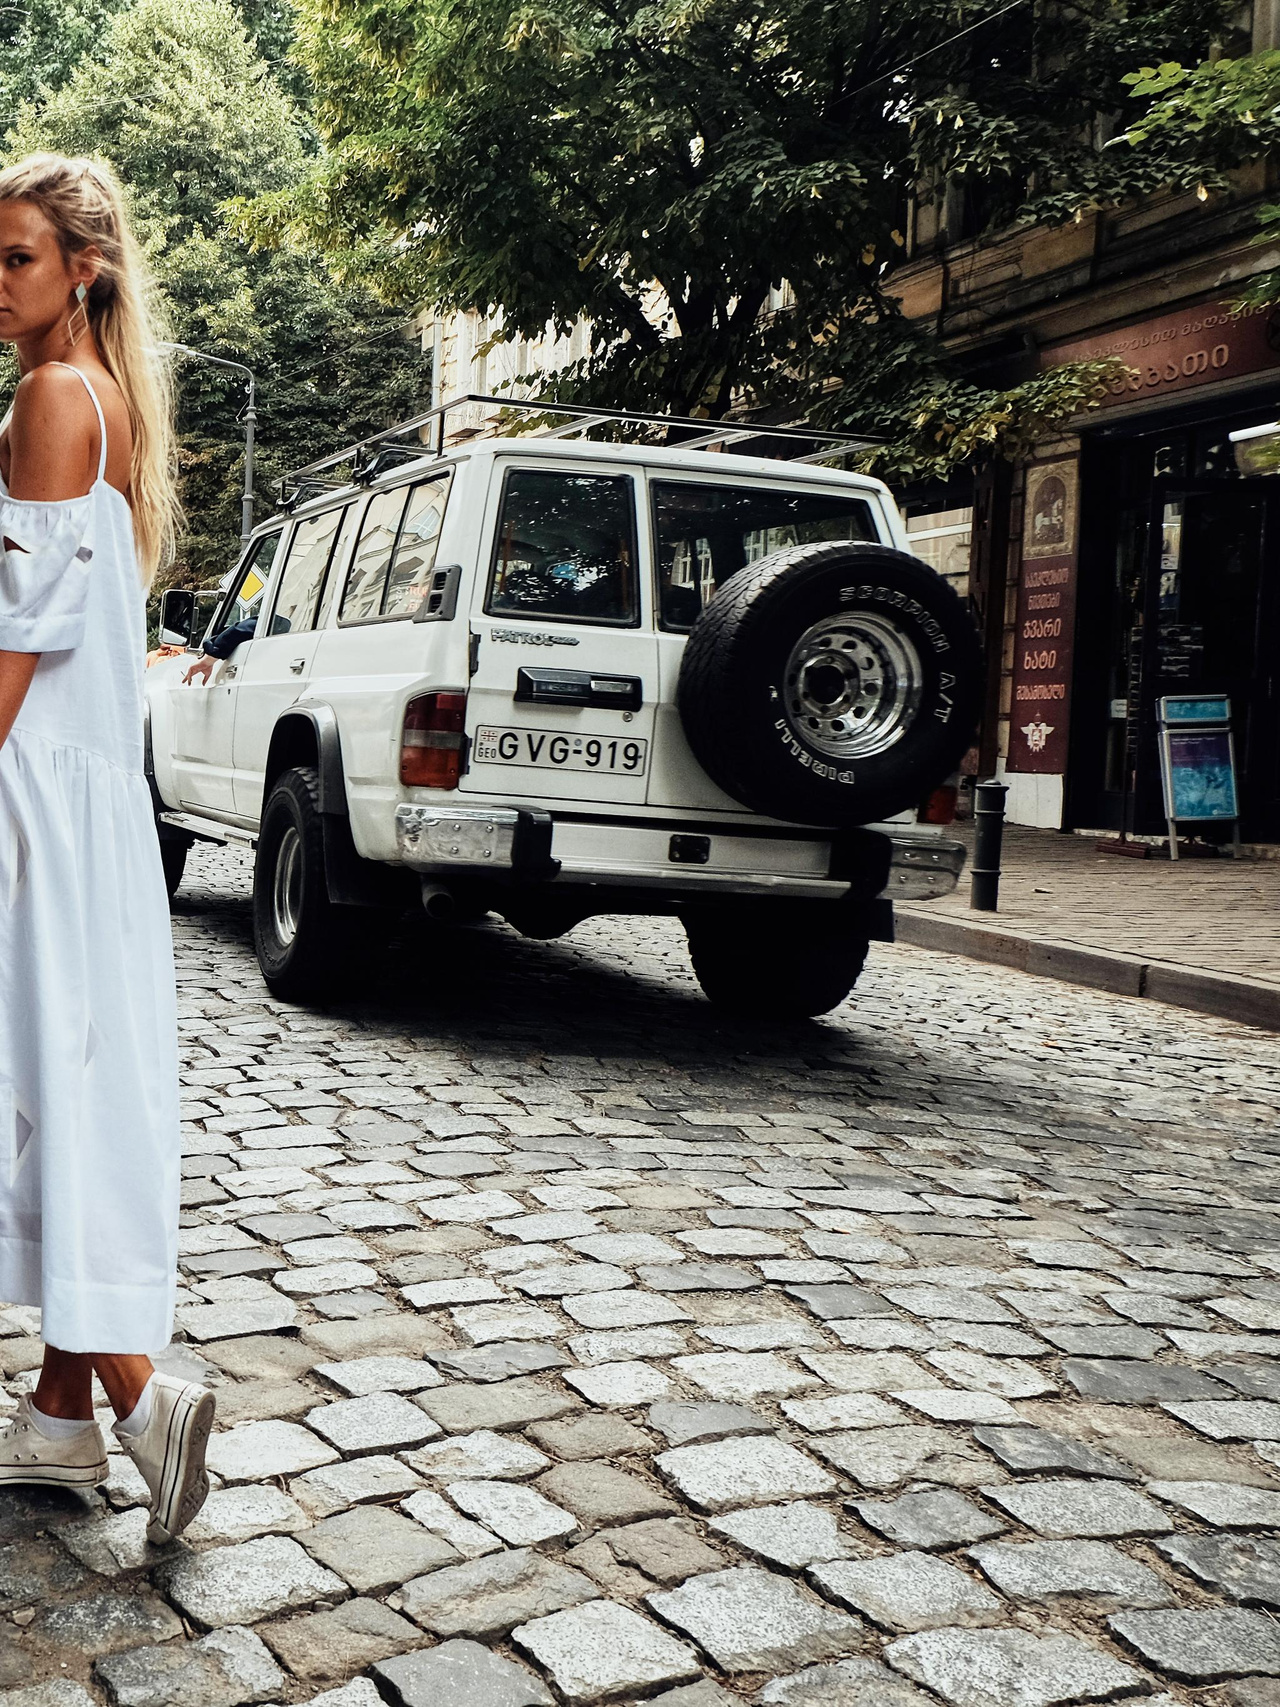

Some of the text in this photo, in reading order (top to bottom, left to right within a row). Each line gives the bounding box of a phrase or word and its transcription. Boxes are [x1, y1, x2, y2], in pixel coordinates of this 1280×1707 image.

[491, 628, 553, 646] PATROL
[1023, 618, 1062, 639] ჯვარი
[839, 586, 956, 723] SCORPION A/T
[1023, 650, 1057, 670] ხატი
[478, 732, 640, 770] GEO GVG-919
[774, 718, 855, 784] PIRELLI
